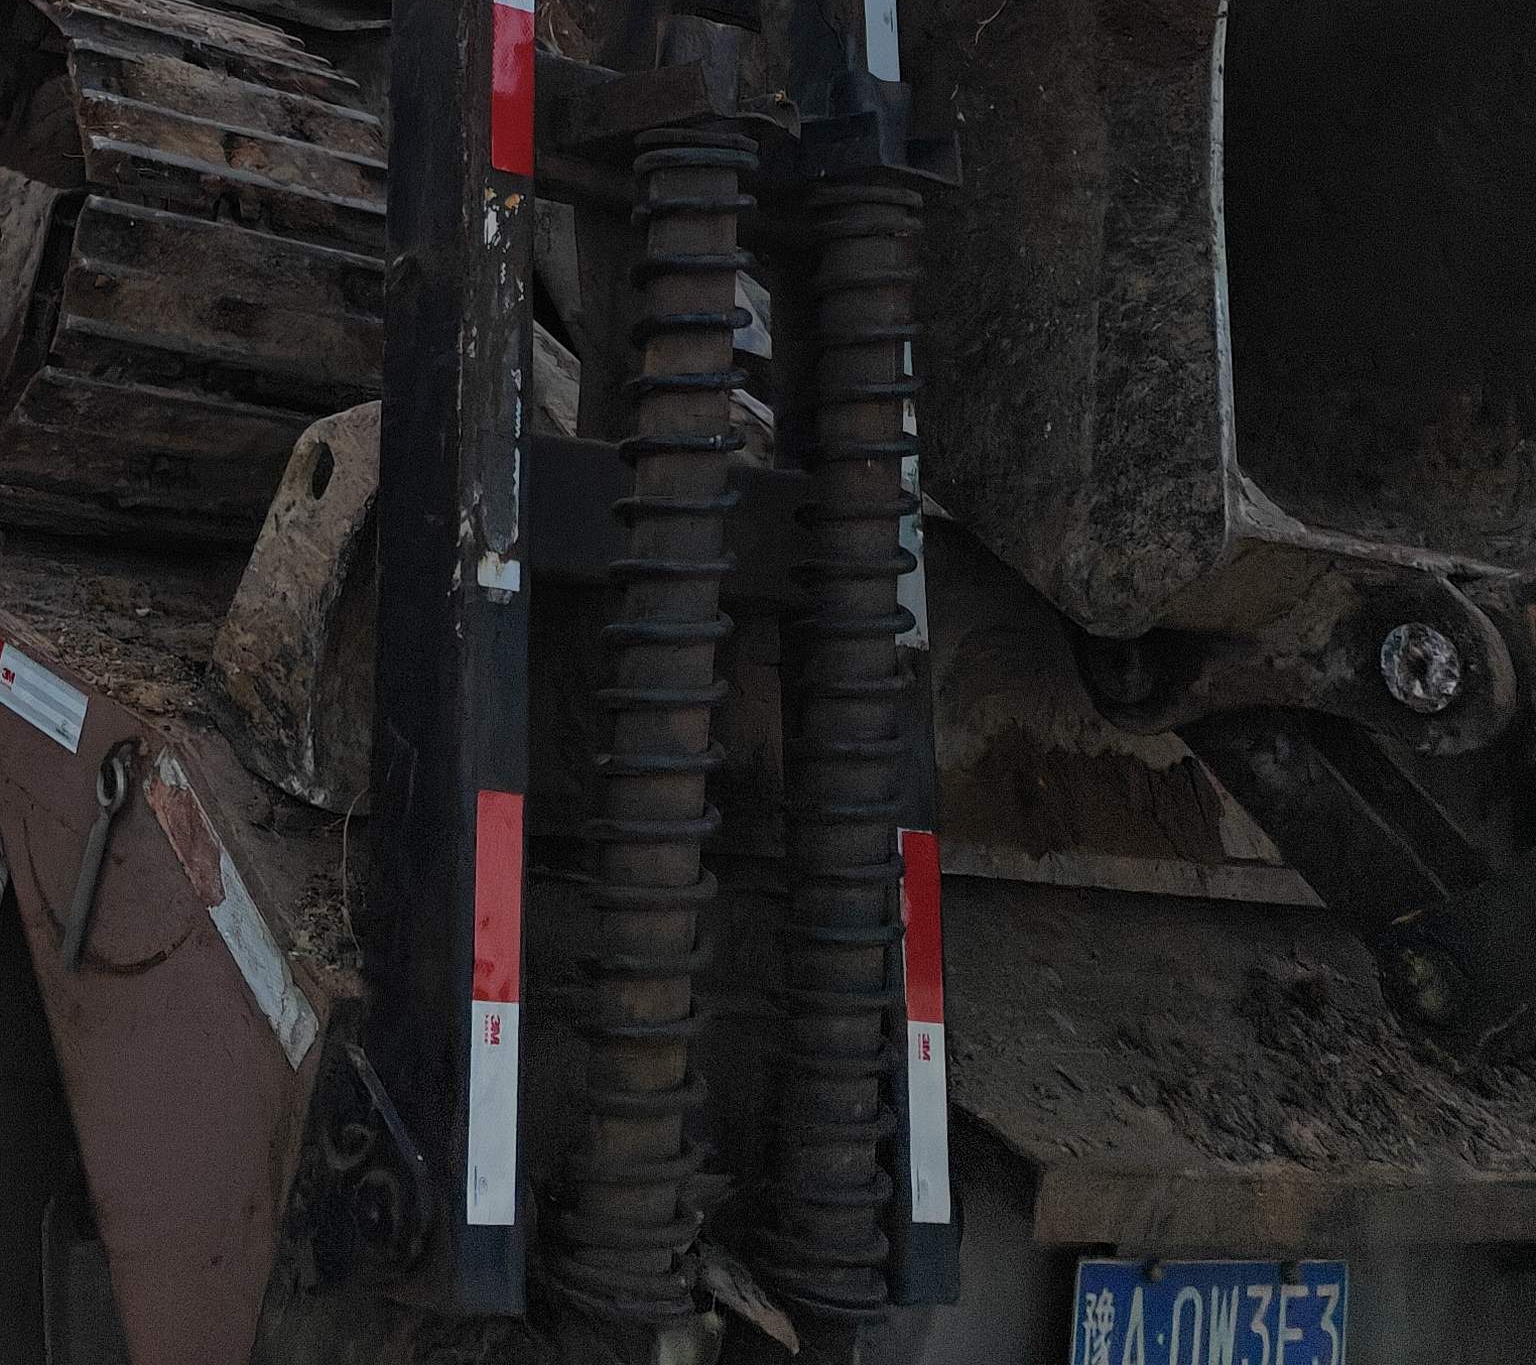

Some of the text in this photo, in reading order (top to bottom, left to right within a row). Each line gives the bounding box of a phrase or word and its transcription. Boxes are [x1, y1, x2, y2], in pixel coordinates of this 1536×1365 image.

[1, 667, 16, 684] 3M
[490, 1013, 501, 1046] 3M
[922, 1032, 931, 1062] 3M
